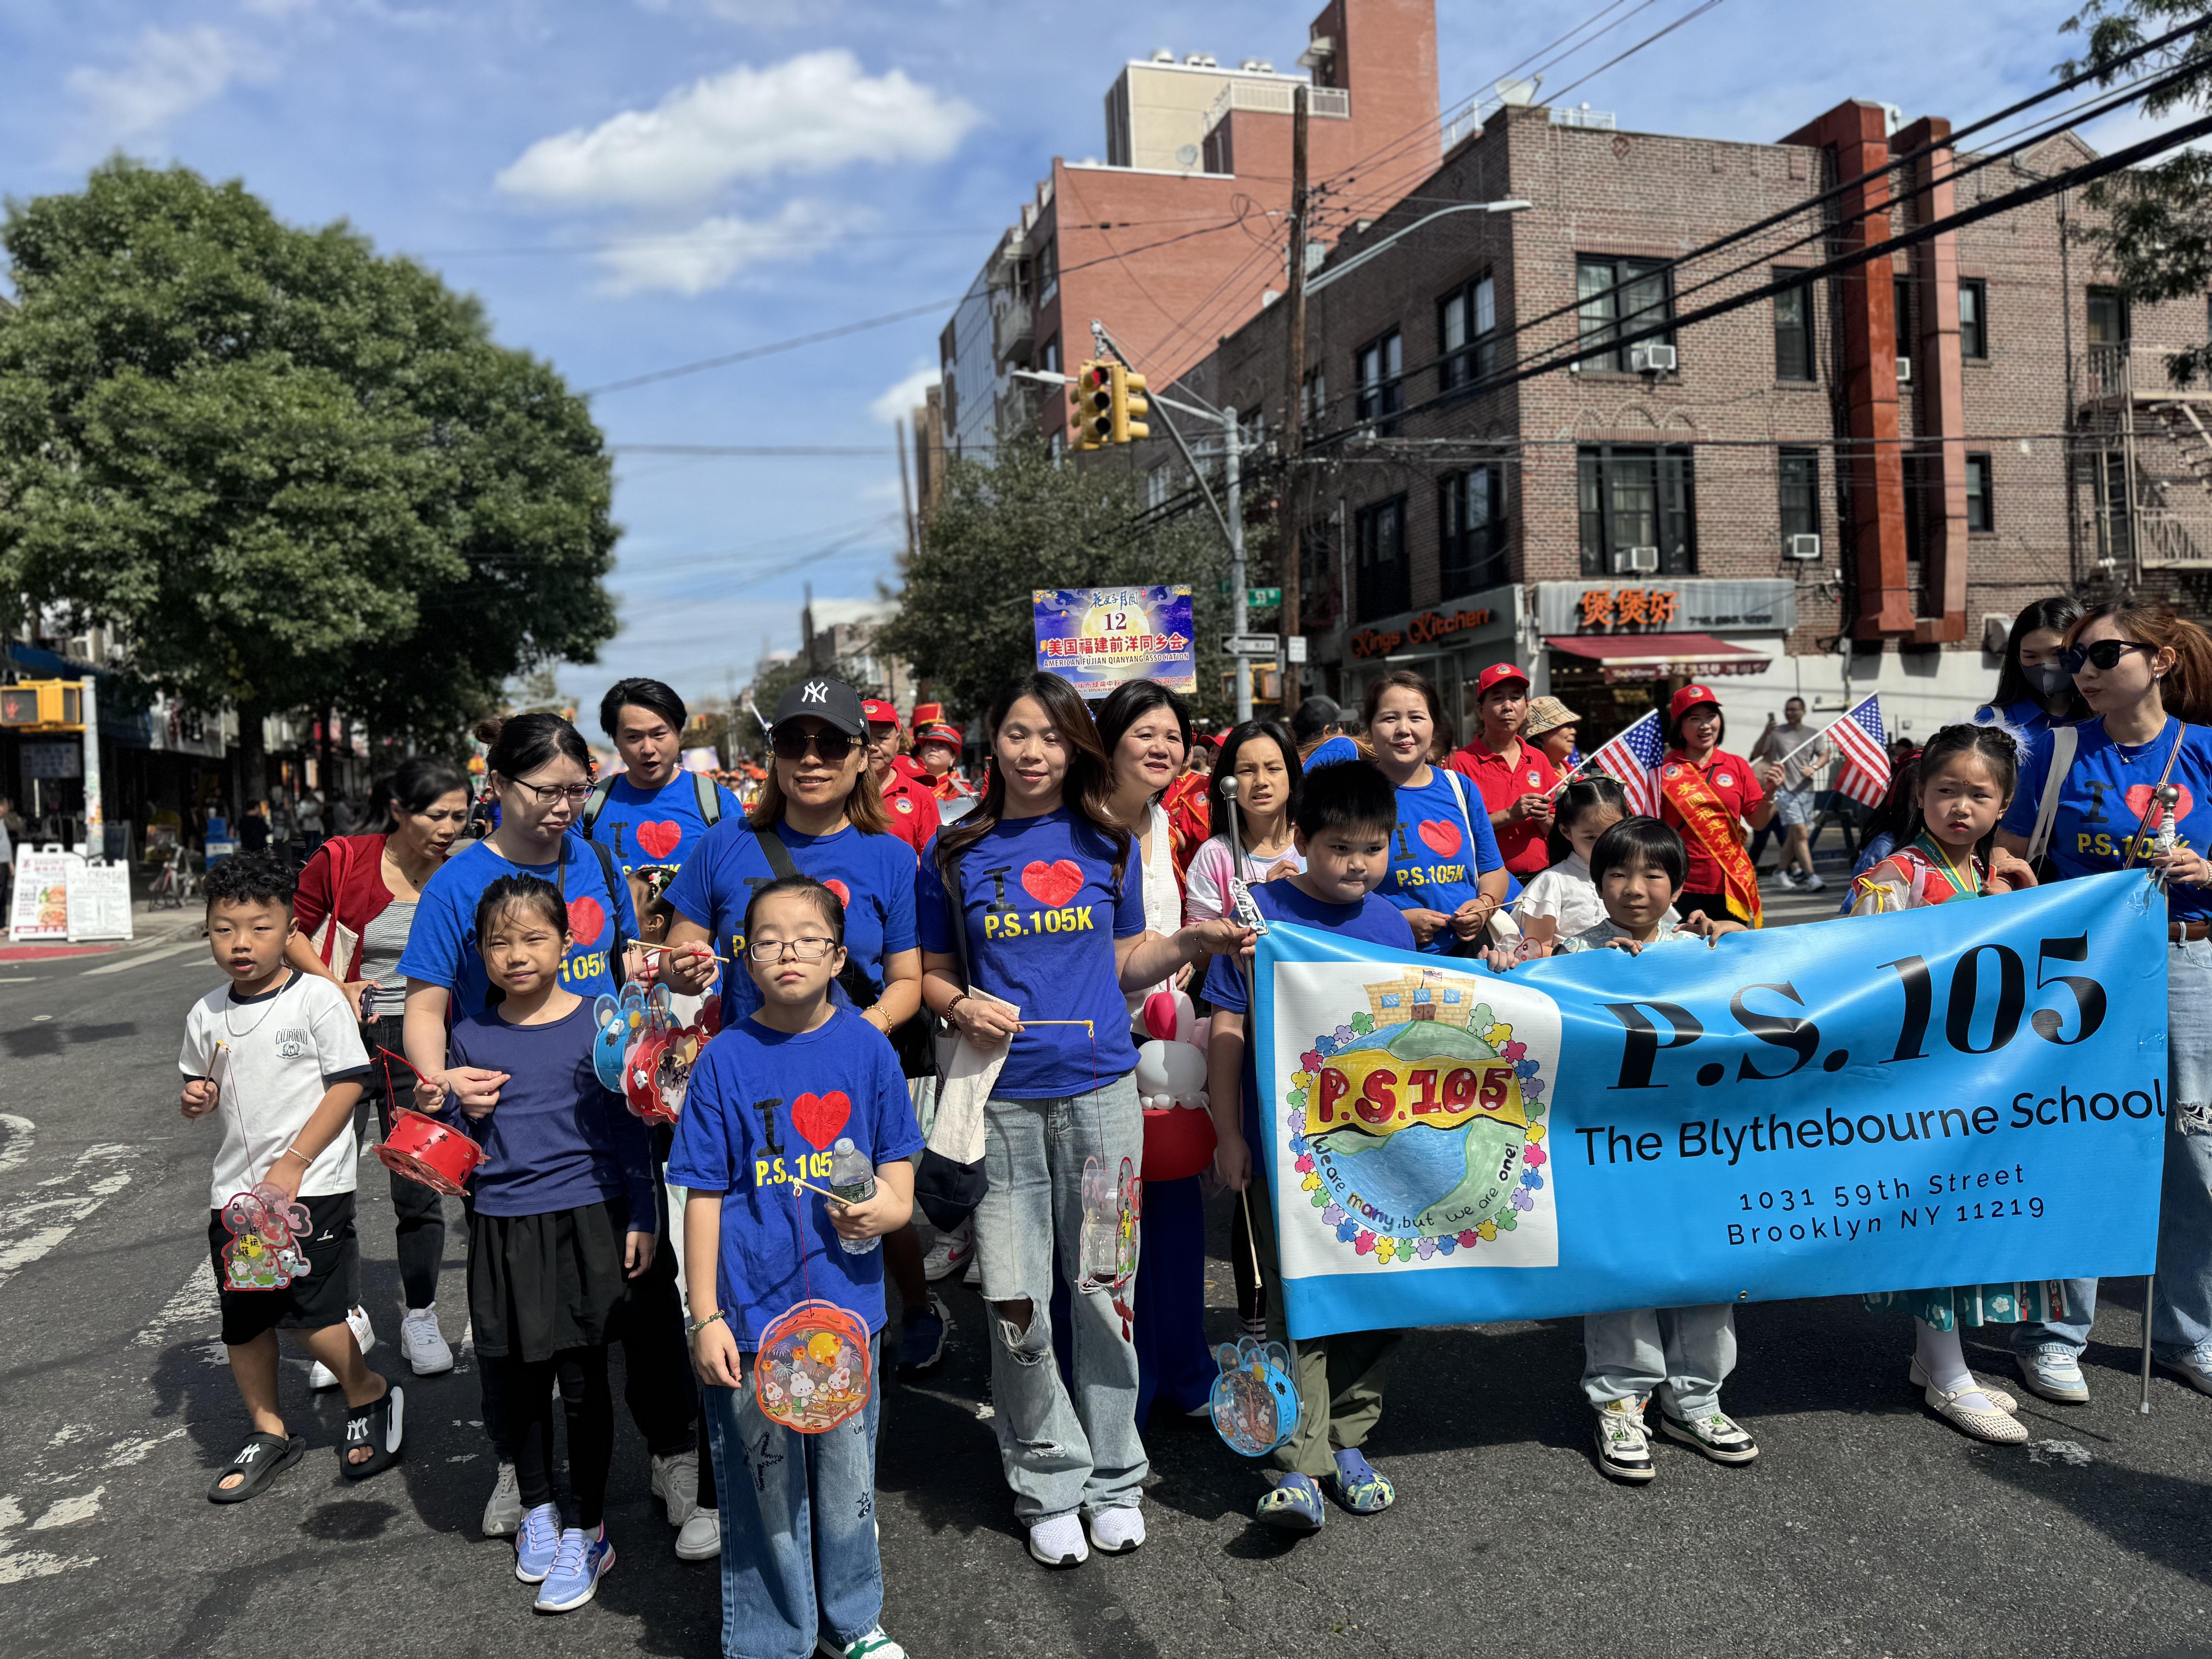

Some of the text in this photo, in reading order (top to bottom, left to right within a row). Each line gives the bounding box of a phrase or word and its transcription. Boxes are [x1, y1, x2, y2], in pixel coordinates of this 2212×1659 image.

[1104, 613, 1127, 630] 12
[1581, 589, 1681, 626] 煲煲好
[1048, 632, 1184, 656] 美国福建前洋同乡会
[1408, 609, 1488, 645] Kitchen
[1044, 653, 1189, 667] AMERICAN FUJIAN QIANYANG ASSOCIATION
[801, 681, 829, 703] NY
[2079, 780, 2114, 823] I
[609, 822, 629, 859] I
[1393, 823, 1417, 862] I
[982, 866, 1016, 913] I
[1396, 865, 1465, 887] P.S.105K
[984, 906, 1094, 939] P.S.105K
[558, 950, 606, 982] 105K
[1876, 930, 2107, 1064] 105
[276, 1030, 307, 1045] CALIFORNIA
[753, 1097, 785, 1158] I
[1575, 1078, 2166, 1166] The Blythebourne School
[756, 1151, 833, 1186] P.S.105
[1311, 1135, 1331, 1166] We
[1327, 1168, 1346, 1193] are
[1402, 1215, 1434, 1229] but
[1446, 1206, 1474, 1223] we
[1479, 1187, 1499, 1209] are
[1499, 1142, 1520, 1182] one!
[1740, 1163, 2025, 1211] 1031 59th Street
[1727, 1197, 2045, 1245] Brooklyn NY 11219
